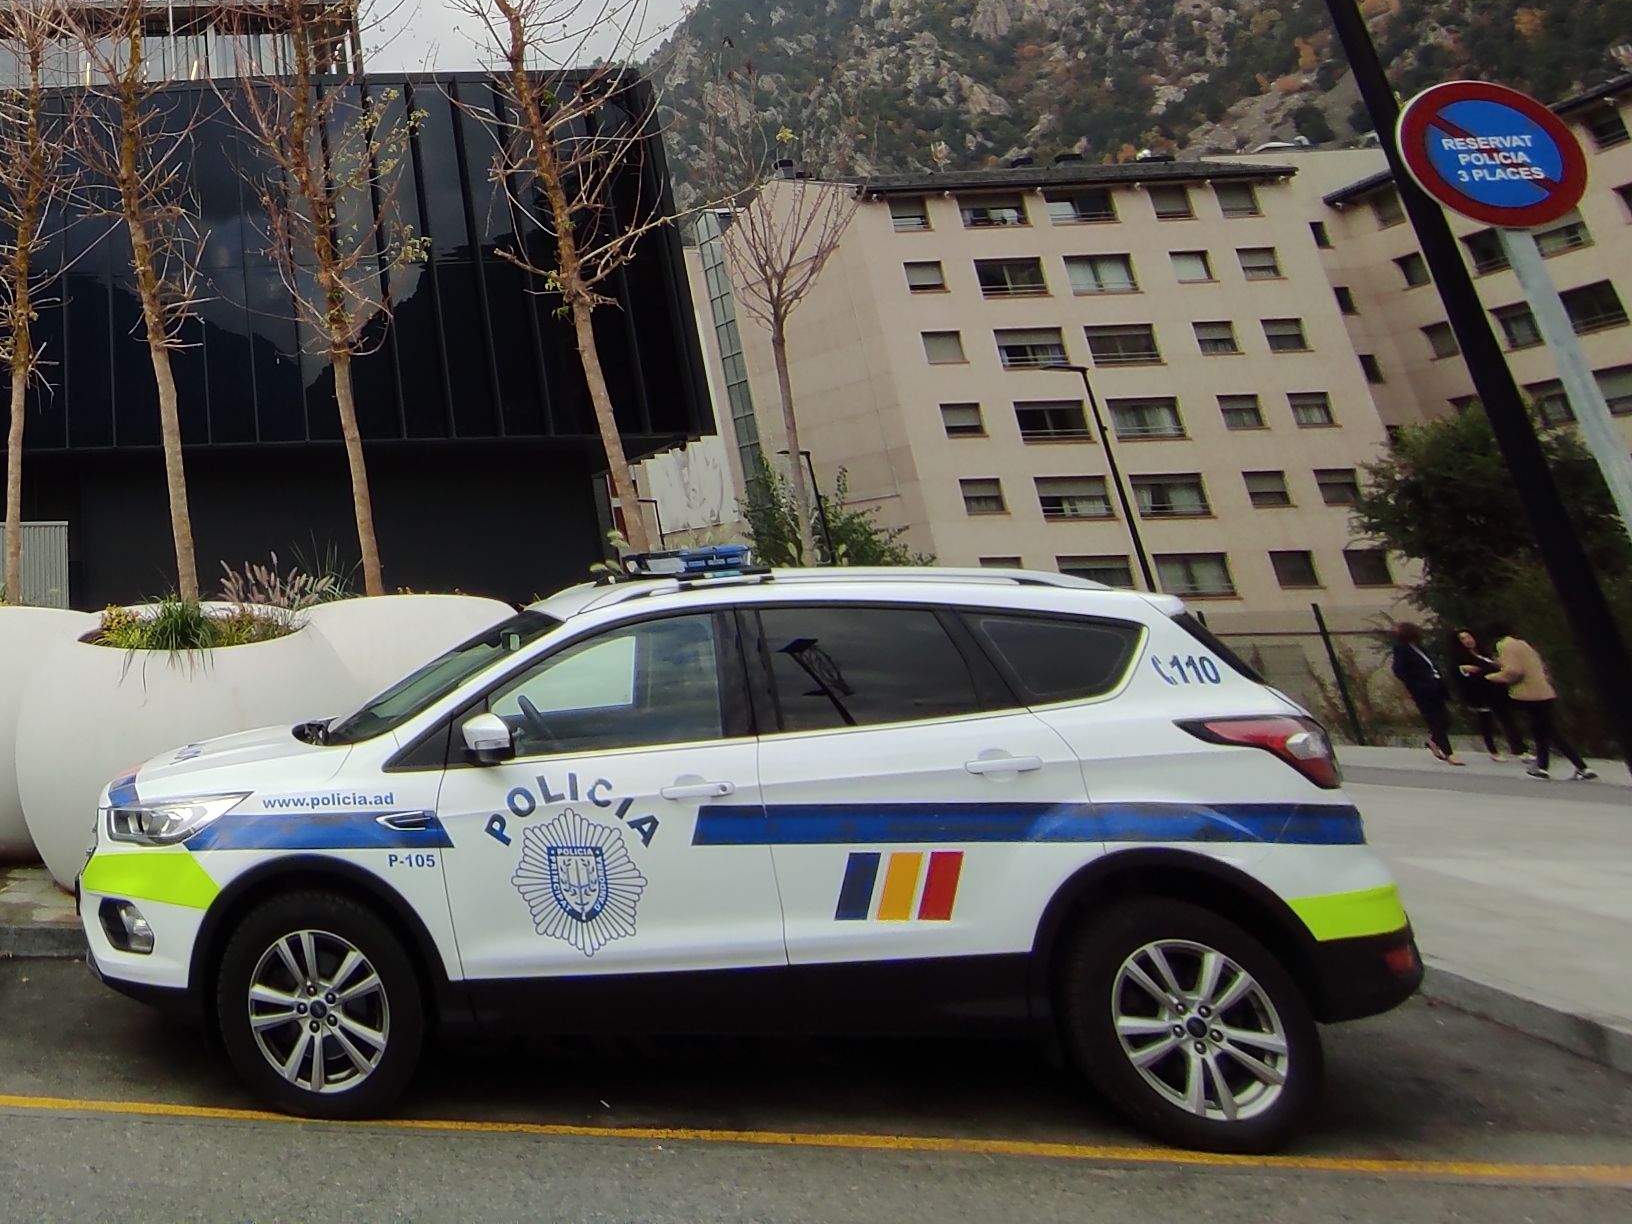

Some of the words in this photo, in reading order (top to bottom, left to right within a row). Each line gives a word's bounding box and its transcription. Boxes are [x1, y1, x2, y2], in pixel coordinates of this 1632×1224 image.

[1441, 135, 1533, 151] RESERVAT
[1458, 151, 1532, 166] POLICIA
[1457, 169, 1470, 183] 3
[1473, 166, 1546, 182] PLACES
[1170, 655, 1221, 684] 110
[262, 792, 394, 809] www.policia.ad
[484, 772, 660, 848] POLICIA
[557, 847, 594, 856] POLICIA
[388, 854, 435, 868] P-105
